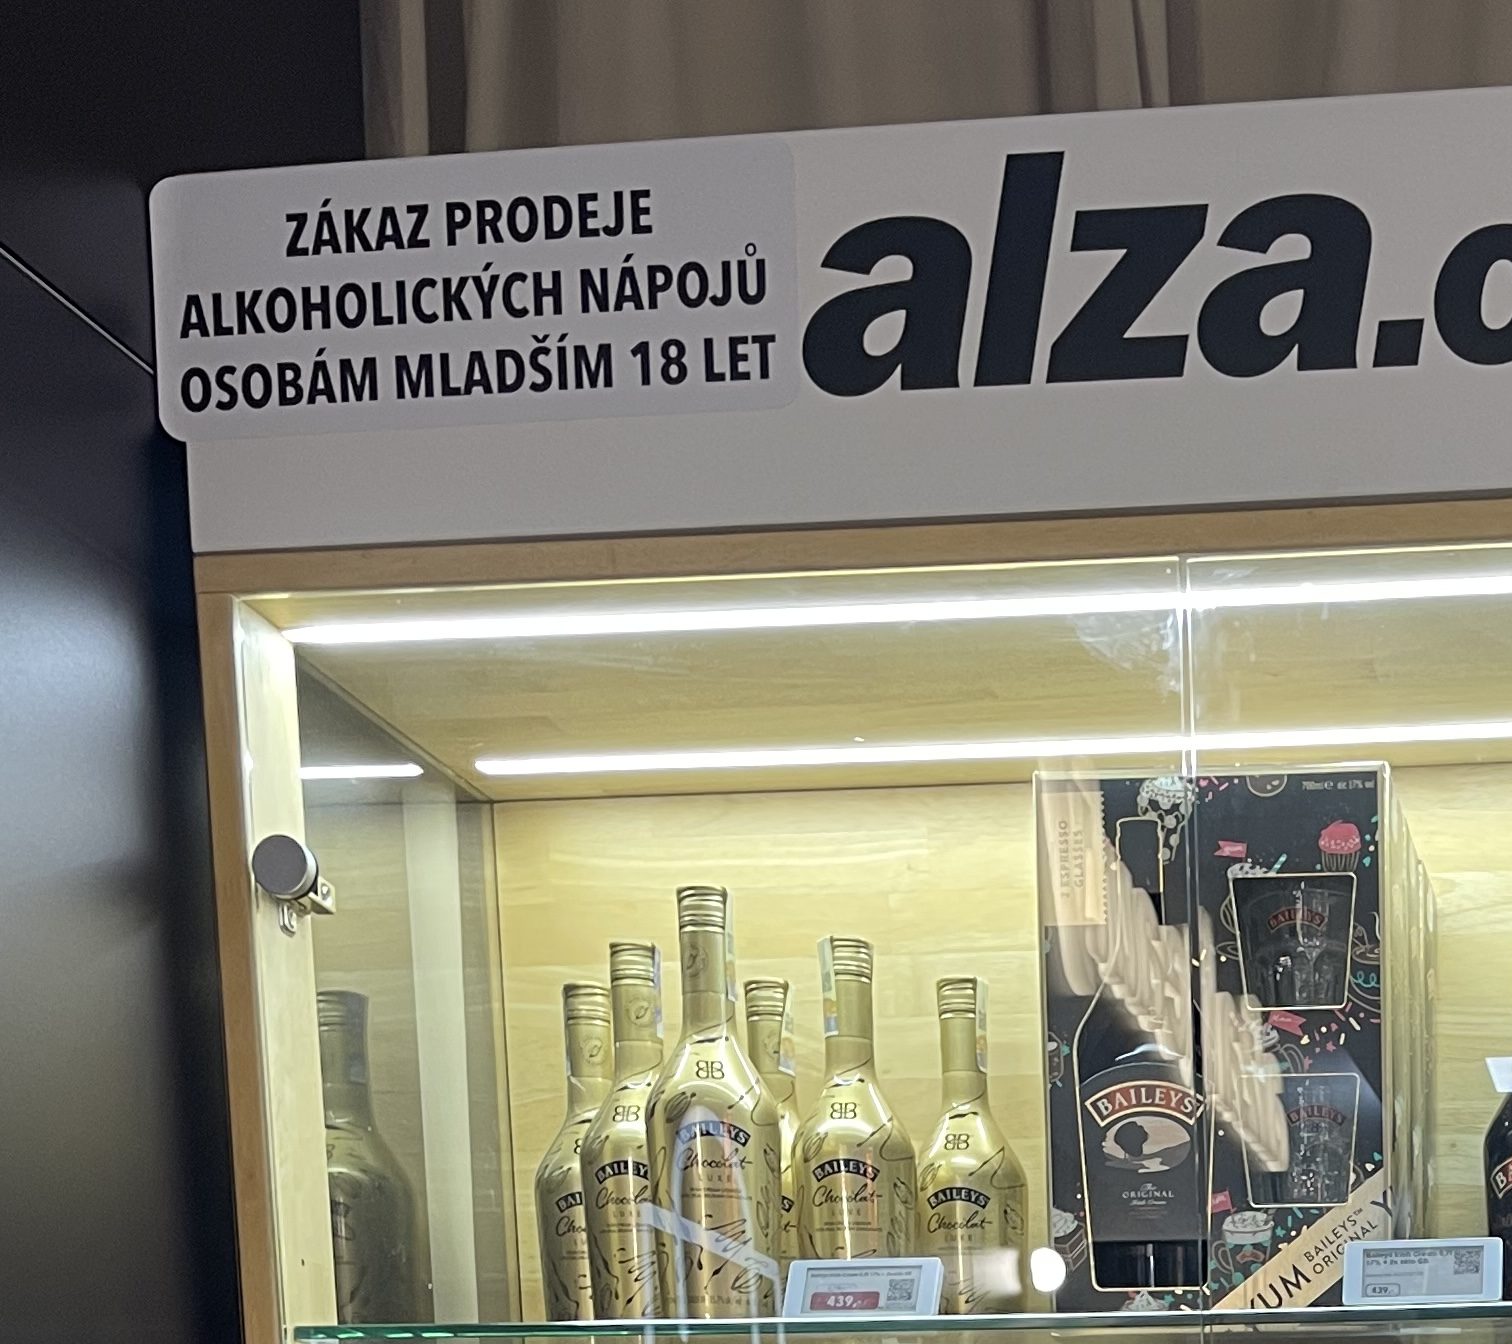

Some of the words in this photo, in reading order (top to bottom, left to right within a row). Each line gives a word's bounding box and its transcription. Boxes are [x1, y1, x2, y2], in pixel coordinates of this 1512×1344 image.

[285, 199, 430, 258] ZÁKAZ
[447, 188, 654, 248] PRODEJE
[179, 262, 564, 339] ALKOHOLICKÝCH
[581, 242, 767, 314] NÁPOJŮ
[179, 347, 378, 413] OSOBÁM
[394, 333, 614, 399] MLADŠÍM
[632, 341, 687, 386] 18
[704, 333, 777, 382] LET
[1058, 819, 1068, 884] ESPRESSO
[1074, 829, 1084, 888] GLASSES
[1095, 1085, 1197, 1118] BAILEYS
[1288, 1107, 1345, 1126] BAILEYS
[813, 1160, 880, 1183] BAILEYS
[1122, 1189, 1174, 1199] ORIGINAL
[928, 1189, 990, 1209] BAILEYS
